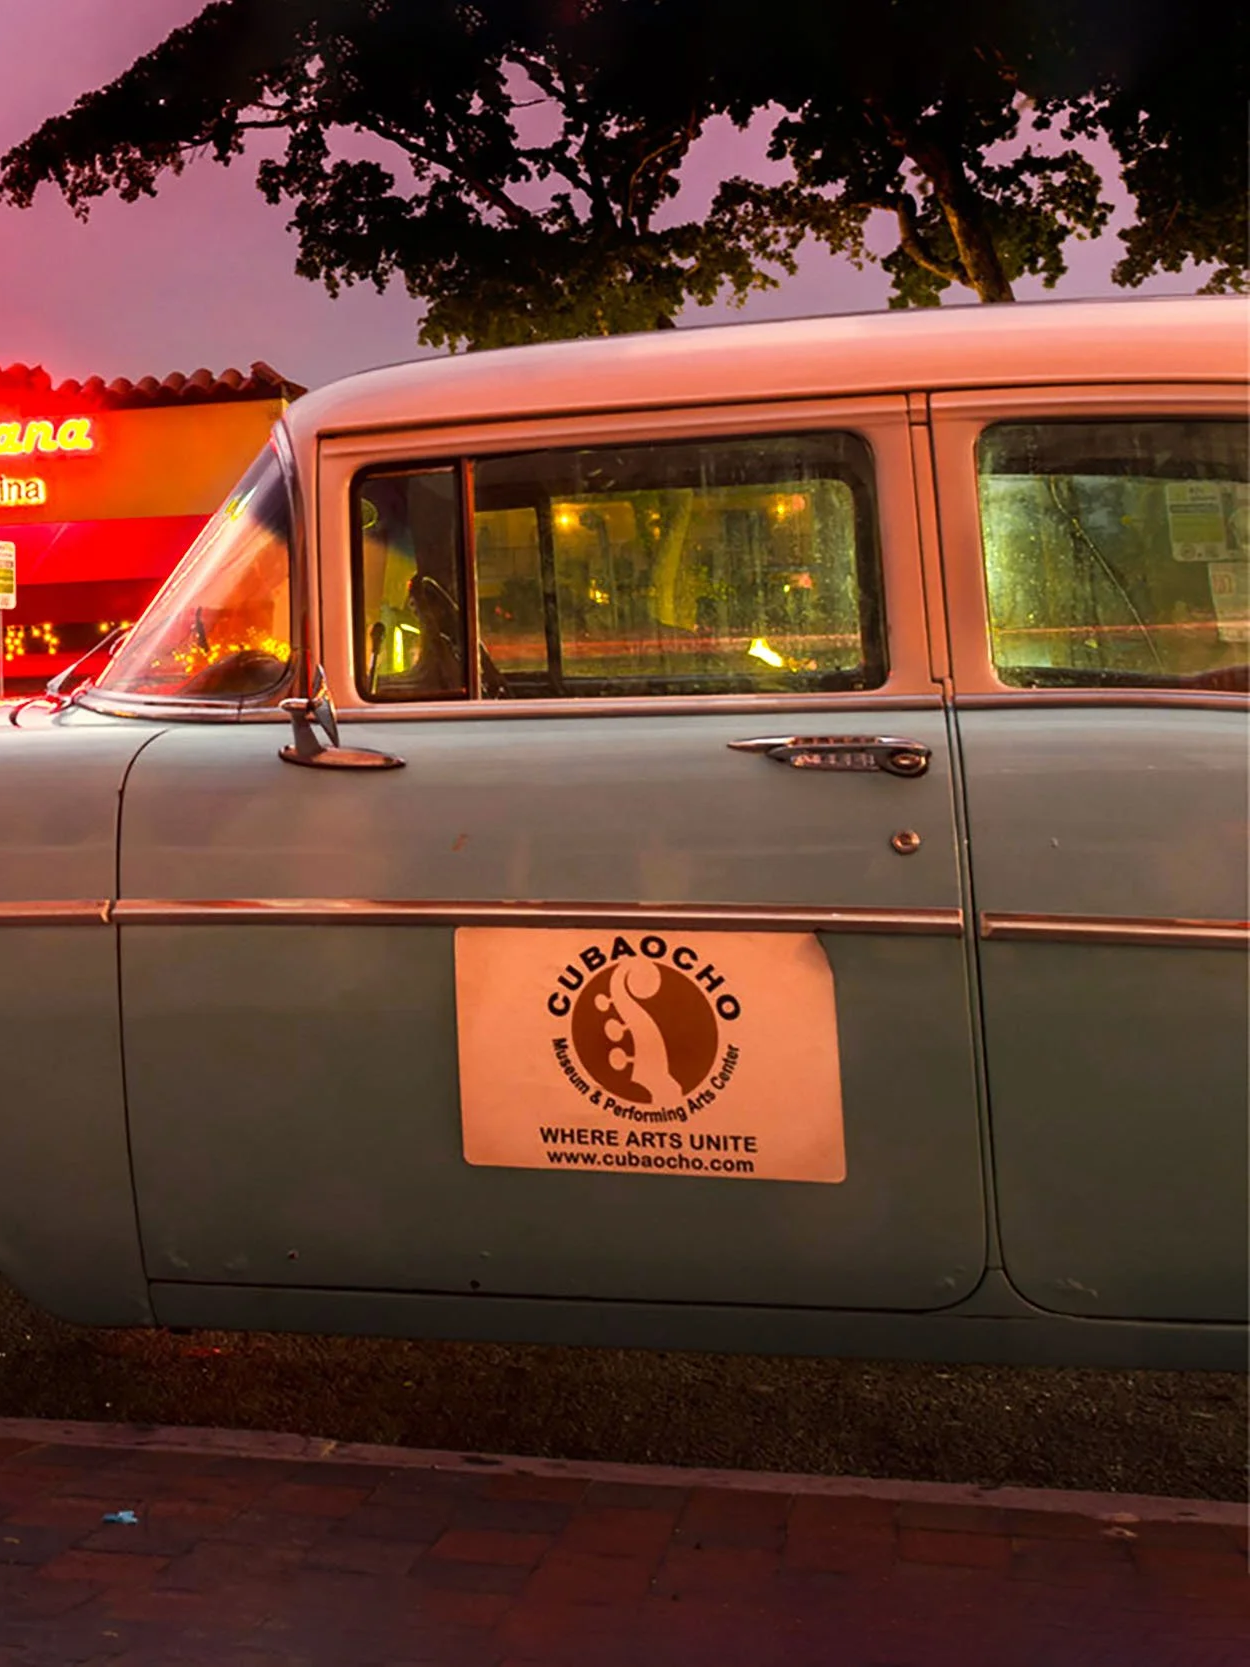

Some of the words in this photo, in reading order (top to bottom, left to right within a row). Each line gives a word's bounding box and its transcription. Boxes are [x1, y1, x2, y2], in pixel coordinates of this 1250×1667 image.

[547, 935, 741, 1021] CUBAOCHO
[552, 1037, 591, 1096] Museum
[589, 1090, 604, 1105] &
[603, 1097, 688, 1123] Performing
[686, 1089, 717, 1115] Arts
[710, 1043, 740, 1091] Center
[539, 1127, 619, 1146] WHERE
[625, 1130, 683, 1149] ARTS
[690, 1133, 759, 1153] UNITE
[547, 1151, 755, 1173] www.cubaocho.com
